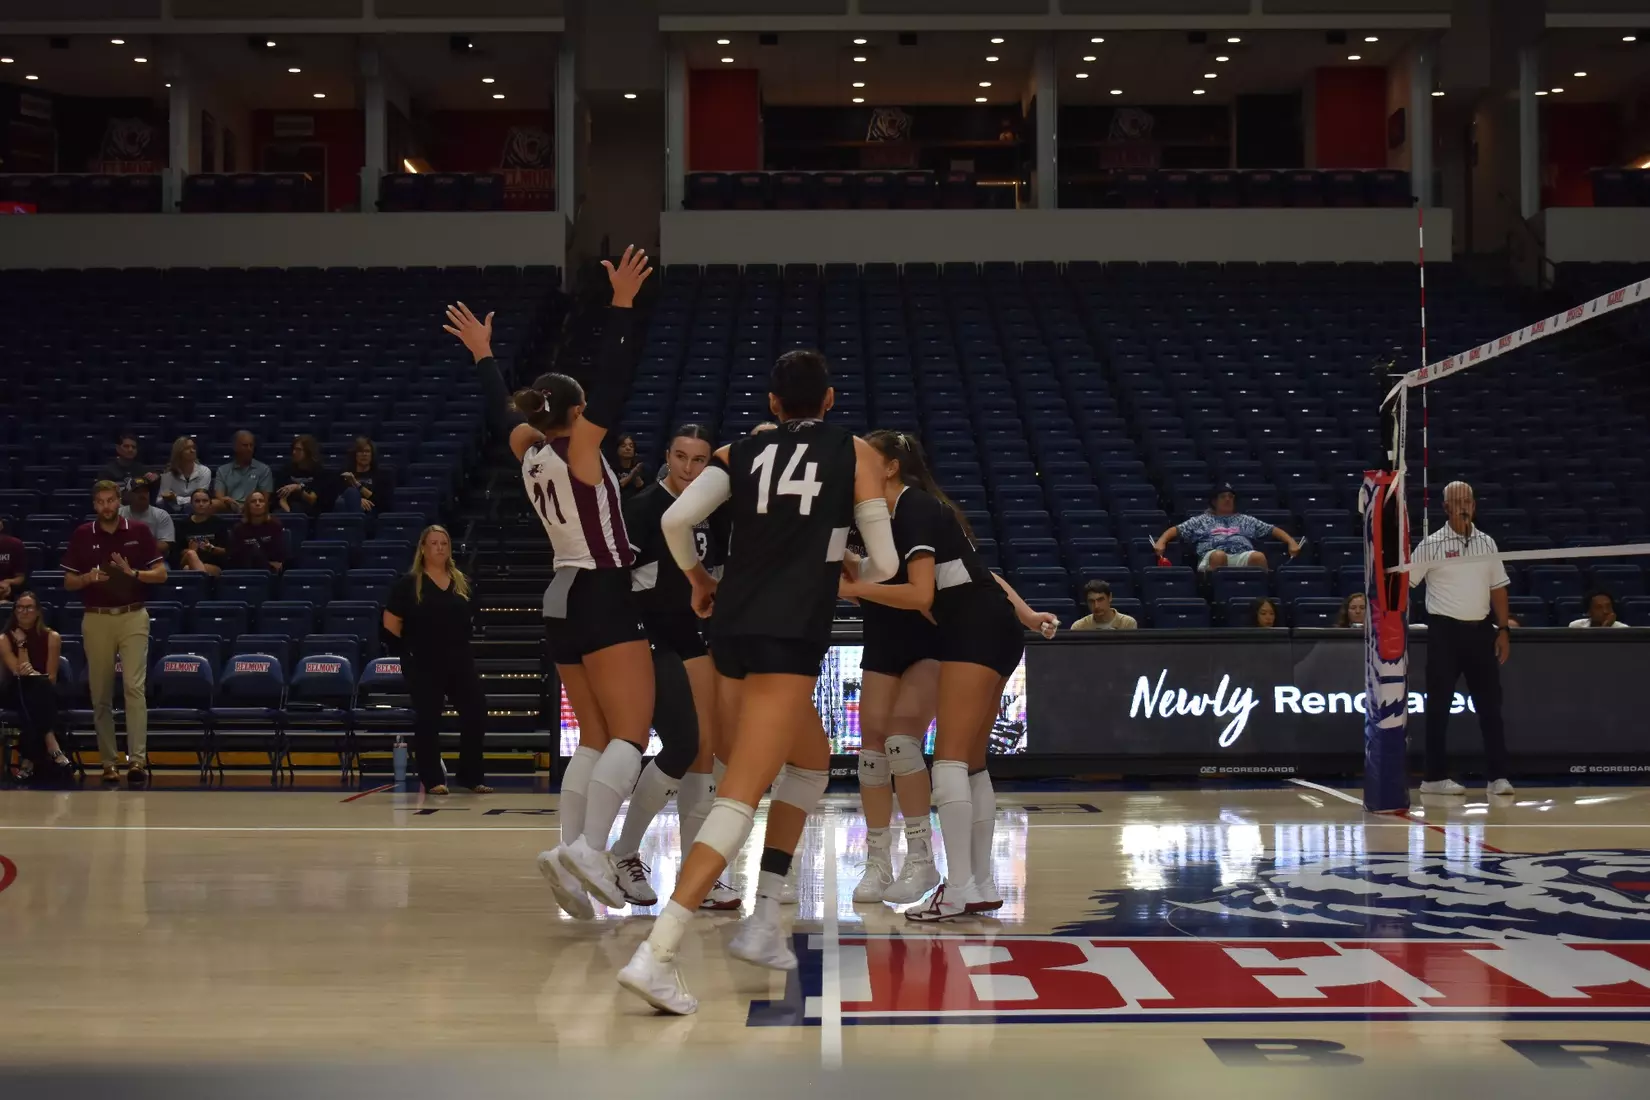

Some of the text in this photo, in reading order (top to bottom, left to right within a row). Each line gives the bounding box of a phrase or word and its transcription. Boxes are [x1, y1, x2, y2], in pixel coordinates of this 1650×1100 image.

[749, 443, 823, 516] 14
[533, 479, 567, 525] 11
[164, 661, 201, 672] BELMONT
[234, 661, 271, 673] BELMONT
[305, 662, 342, 673] BELMONT
[375, 663, 403, 673] BELMO
[1129, 668, 1260, 748] Newly
[1200, 766, 1217, 774] OES
[1569, 765, 1587, 773] OES
